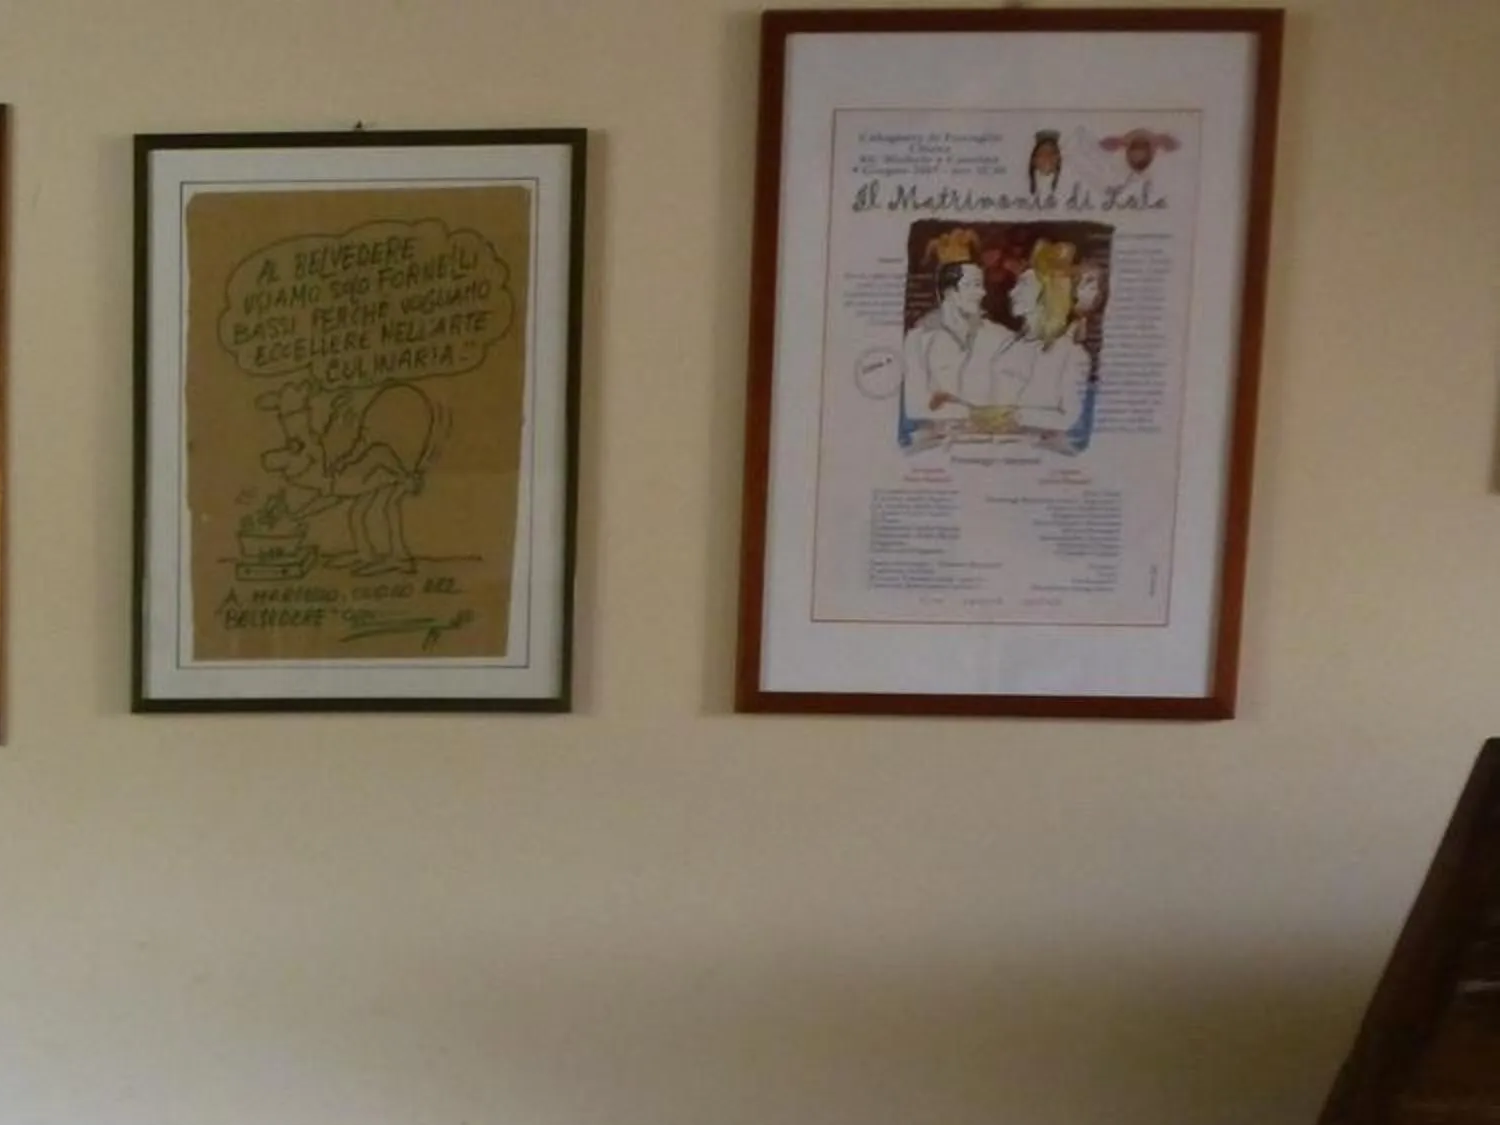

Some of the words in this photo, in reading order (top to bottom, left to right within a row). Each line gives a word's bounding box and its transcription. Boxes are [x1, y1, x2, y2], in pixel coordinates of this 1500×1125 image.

[888, 183, 1058, 212] Matrimonio
[1066, 181, 1095, 211] di
[257, 260, 281, 283] AL
[295, 237, 417, 277] BELVEDERE
[377, 244, 480, 290] FORNELLI
[233, 316, 297, 345] BASSI
